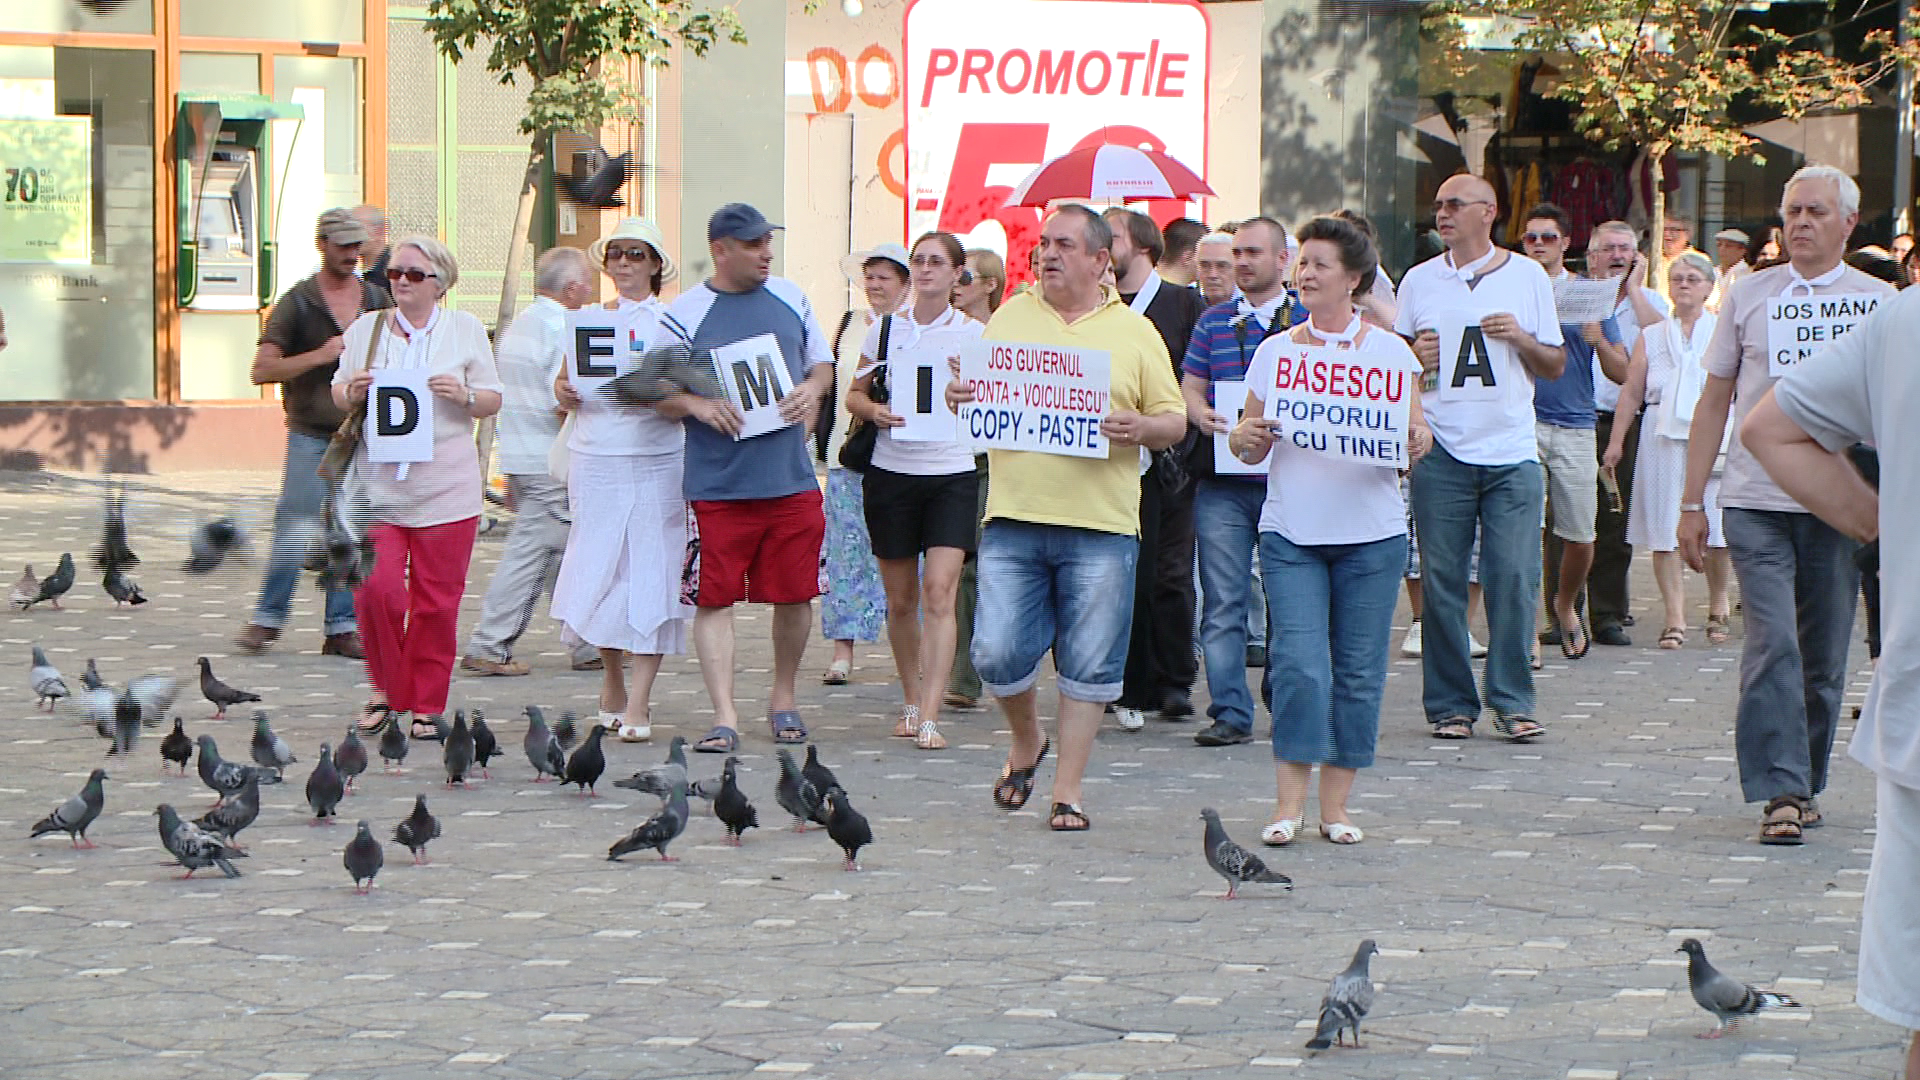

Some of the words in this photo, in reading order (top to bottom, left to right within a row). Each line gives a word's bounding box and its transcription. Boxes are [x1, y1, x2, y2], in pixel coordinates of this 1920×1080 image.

[921, 39, 1190, 107] PROMOTIE
[5, 166, 39, 203] 70
[1772, 303, 1813, 320] JOS
[1797, 326, 1824, 342] DE
[575, 327, 617, 377] E
[988, 346, 1012, 370] JOS
[1016, 349, 1083, 377] GUVERNUL
[1451, 326, 1496, 387] A
[731, 353, 784, 411] M
[916, 365, 933, 414] I
[1276, 352, 1403, 402] BĂSESCU
[376, 386, 420, 436] D
[1276, 399, 1397, 432] POPORUL
[1293, 431, 1326, 451] CU
[1336, 435, 1400, 461] TINE!
